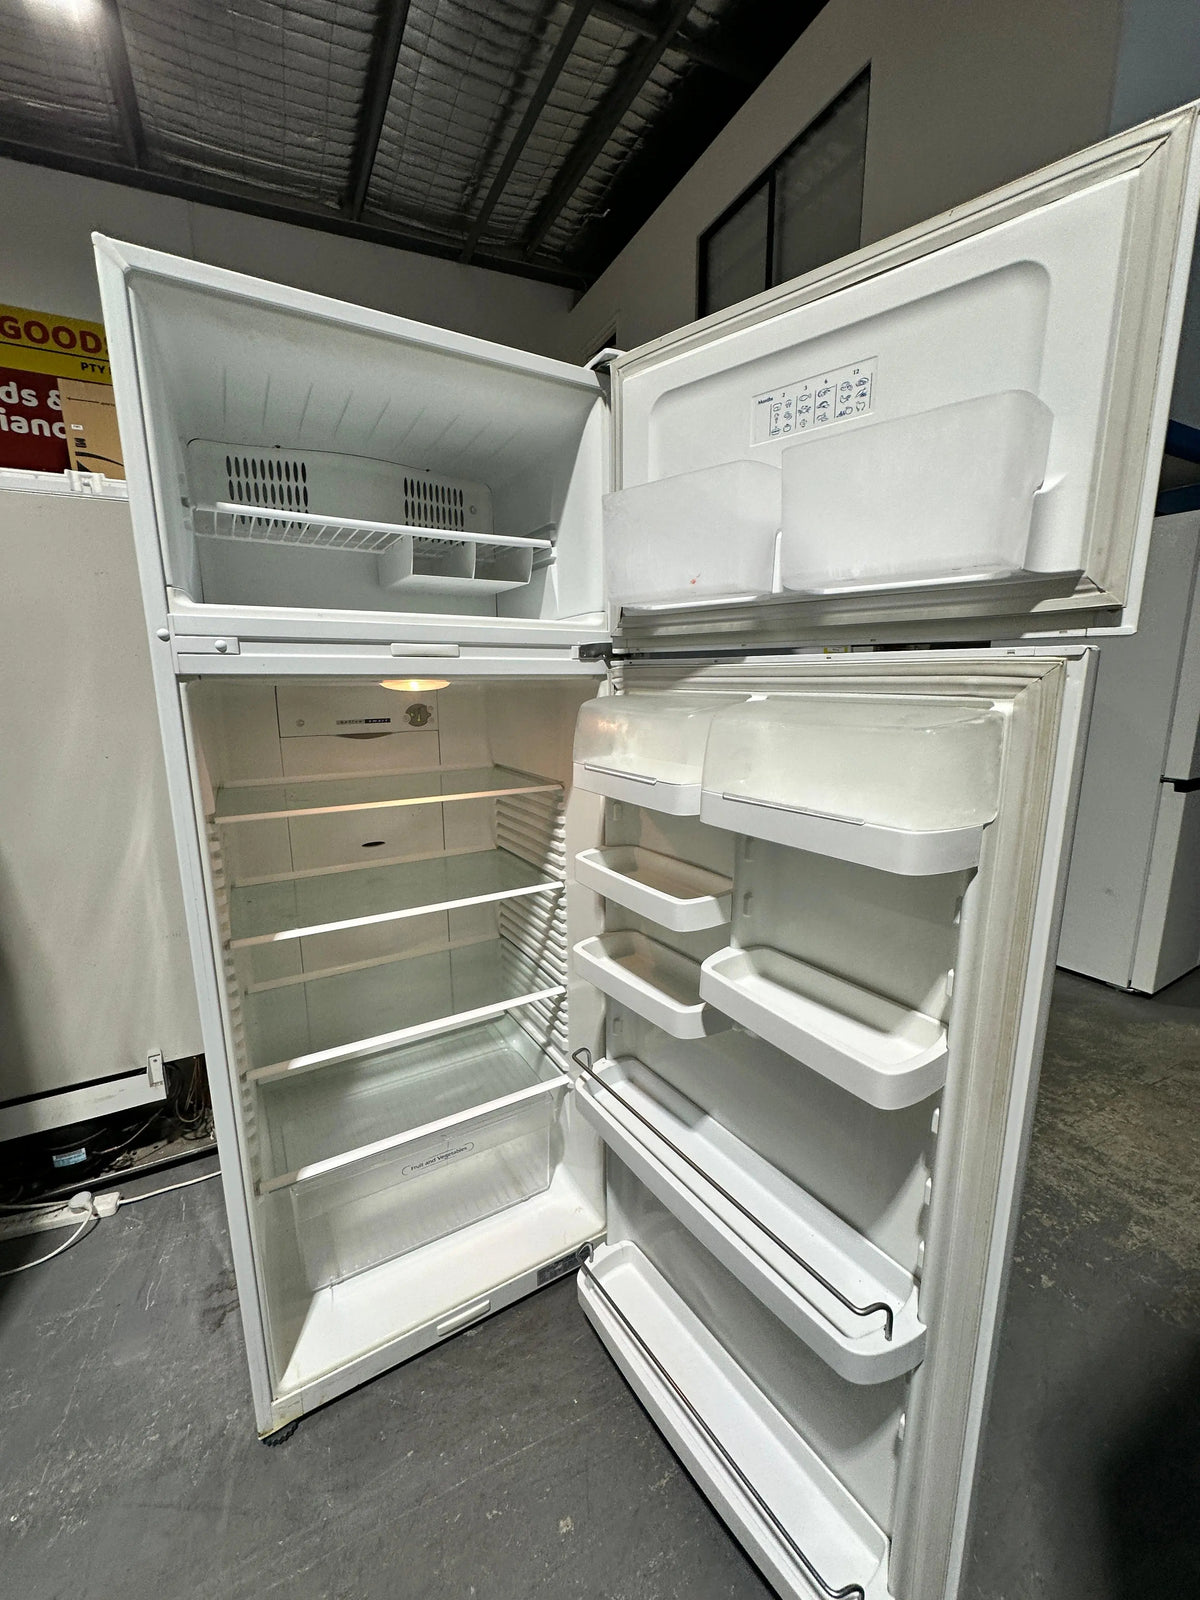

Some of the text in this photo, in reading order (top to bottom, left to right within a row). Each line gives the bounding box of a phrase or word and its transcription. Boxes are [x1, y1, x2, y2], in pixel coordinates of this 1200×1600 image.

[0, 315, 109, 354] GOOD
[81, 362, 105, 374] PTY
[46, 389, 62, 411] &
[410, 1146, 468, 1171] Fruit and Vegetables
